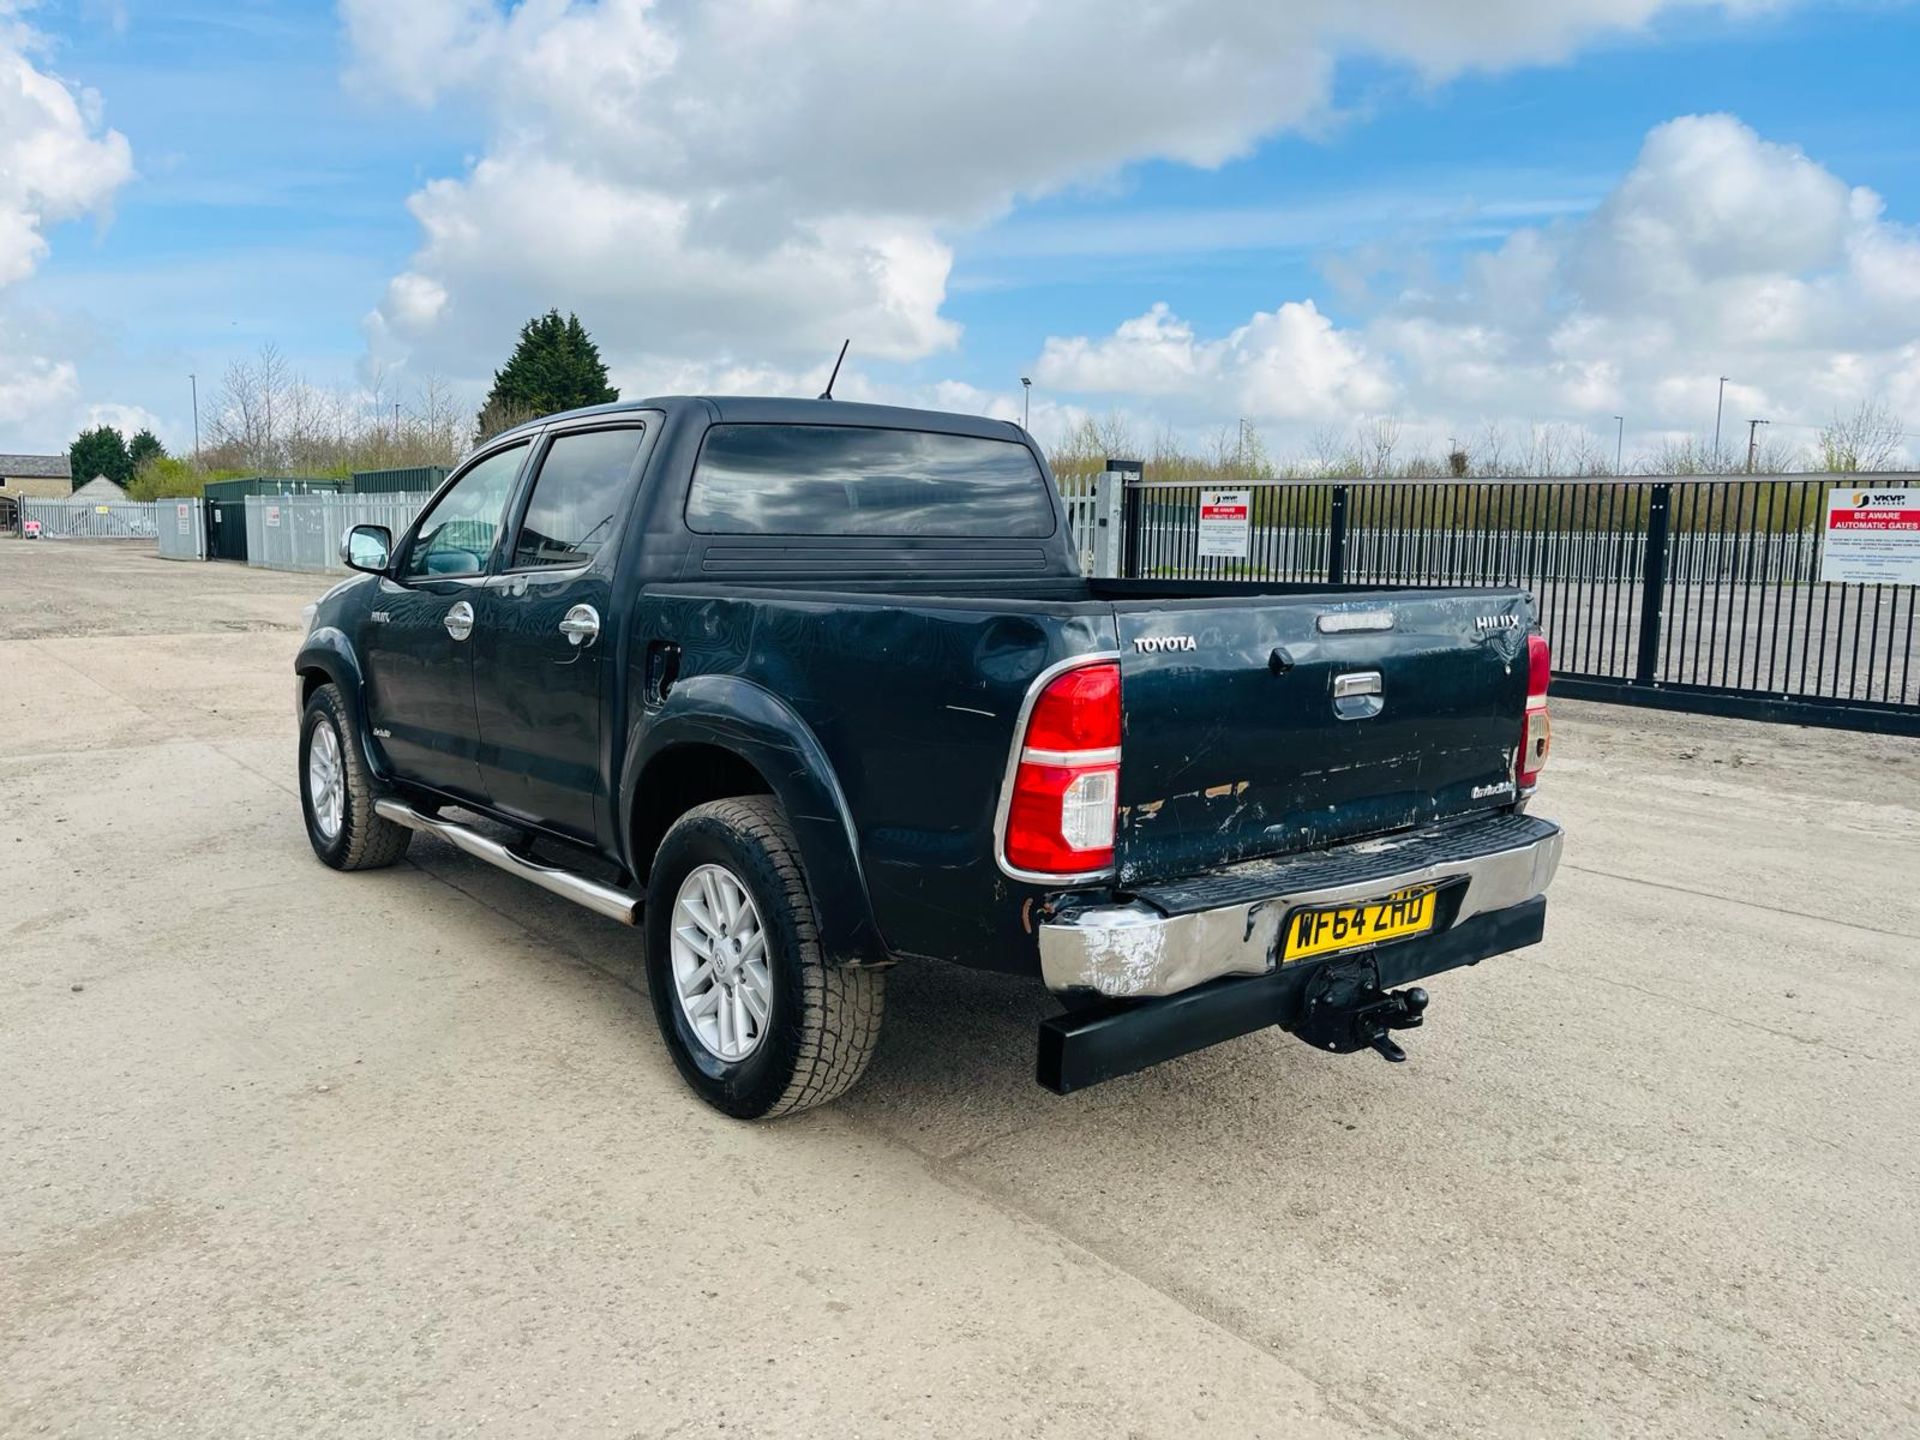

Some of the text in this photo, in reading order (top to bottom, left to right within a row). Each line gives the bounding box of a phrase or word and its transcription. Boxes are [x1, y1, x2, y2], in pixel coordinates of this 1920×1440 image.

[1867, 512, 1901, 520] AWARE
[1835, 521, 1919, 530] AUTOMATIC GATES
[1475, 615, 1519, 630] HILUX
[1133, 635, 1197, 653] TOYOTA
[1297, 890, 1425, 949] WF64 ZHD
